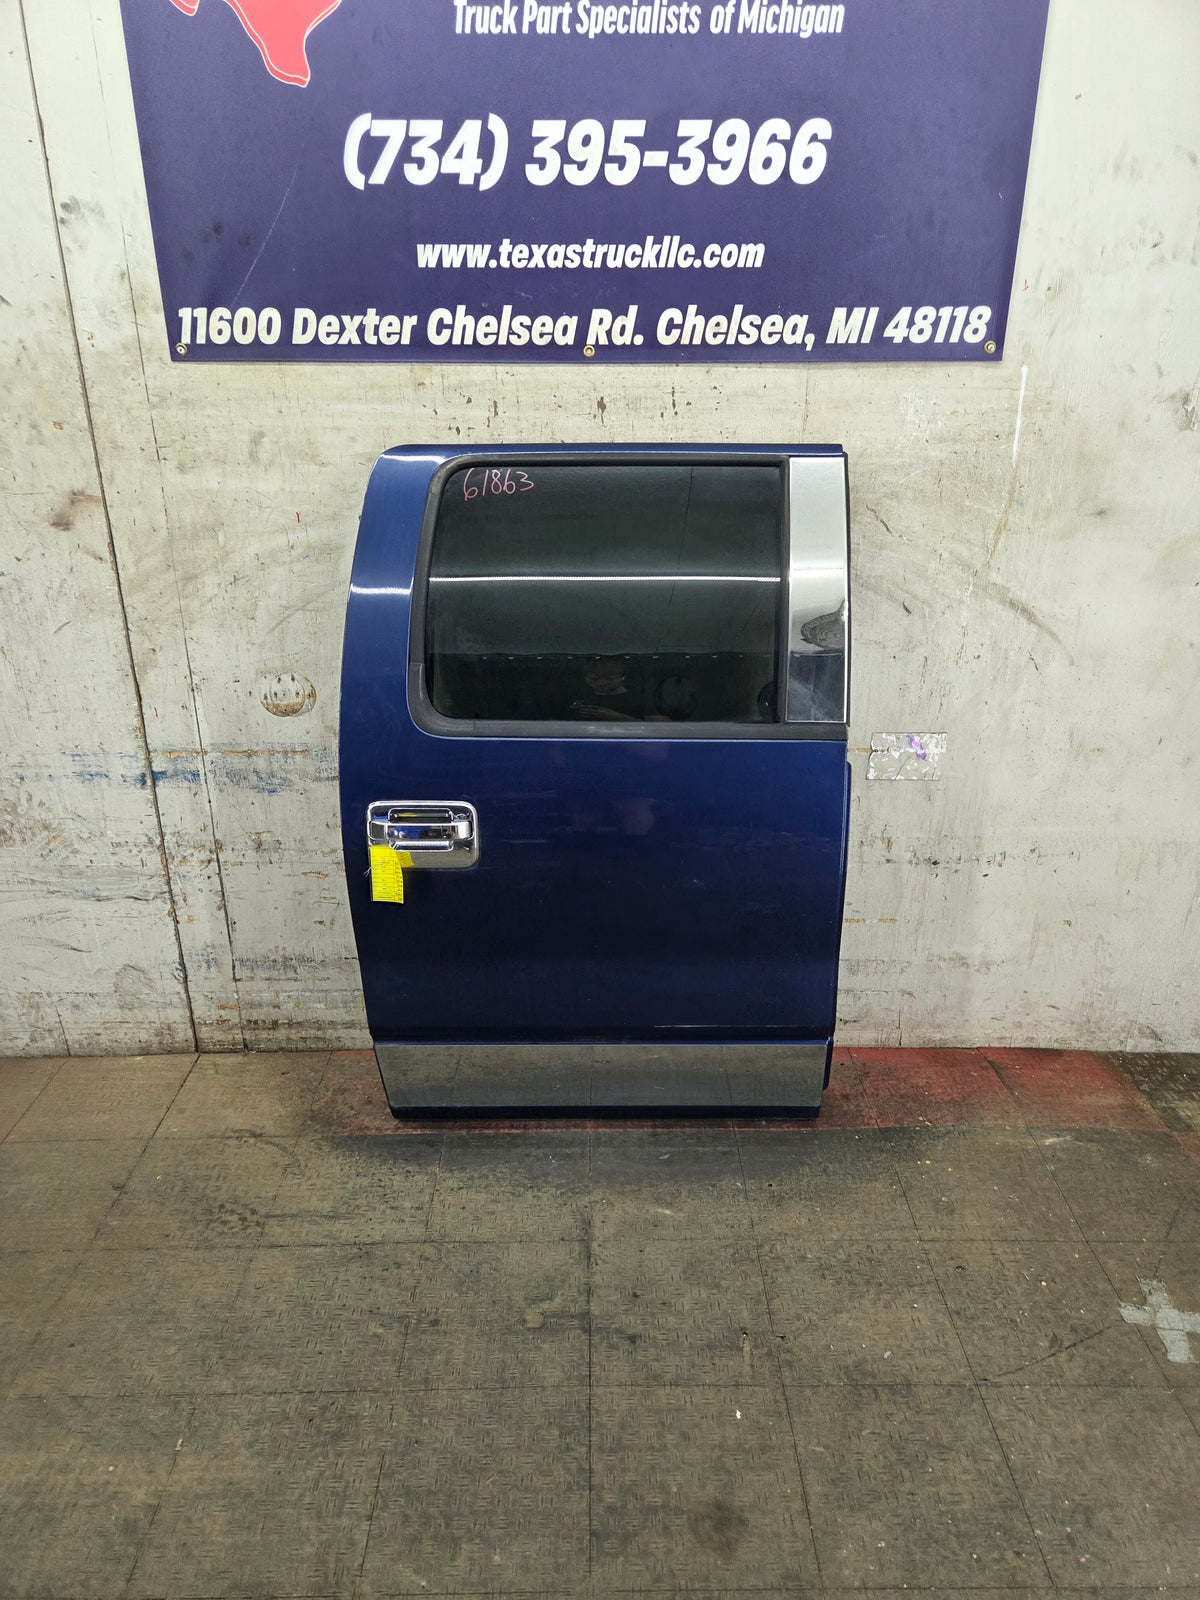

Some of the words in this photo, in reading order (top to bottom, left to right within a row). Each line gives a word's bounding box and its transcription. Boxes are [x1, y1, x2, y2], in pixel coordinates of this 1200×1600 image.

[454, 0, 518, 34] Truck
[522, 0, 573, 34] Part
[575, 0, 702, 38] Specialists
[709, 1, 736, 34] of
[737, 0, 845, 38] Michigan
[343, 112, 508, 191] (734)
[525, 117, 833, 187] 395-3966
[416, 235, 766, 269] www.texastruckllc.com
[177, 306, 282, 346] 11600
[291, 307, 417, 346] Dexter
[427, 304, 579, 346] Chelsea
[586, 304, 644, 346] Rd.
[656, 304, 816, 352] Chelsea,
[825, 306, 879, 344] MI
[882, 305, 992, 344] 48118
[463, 467, 534, 501] 61863
